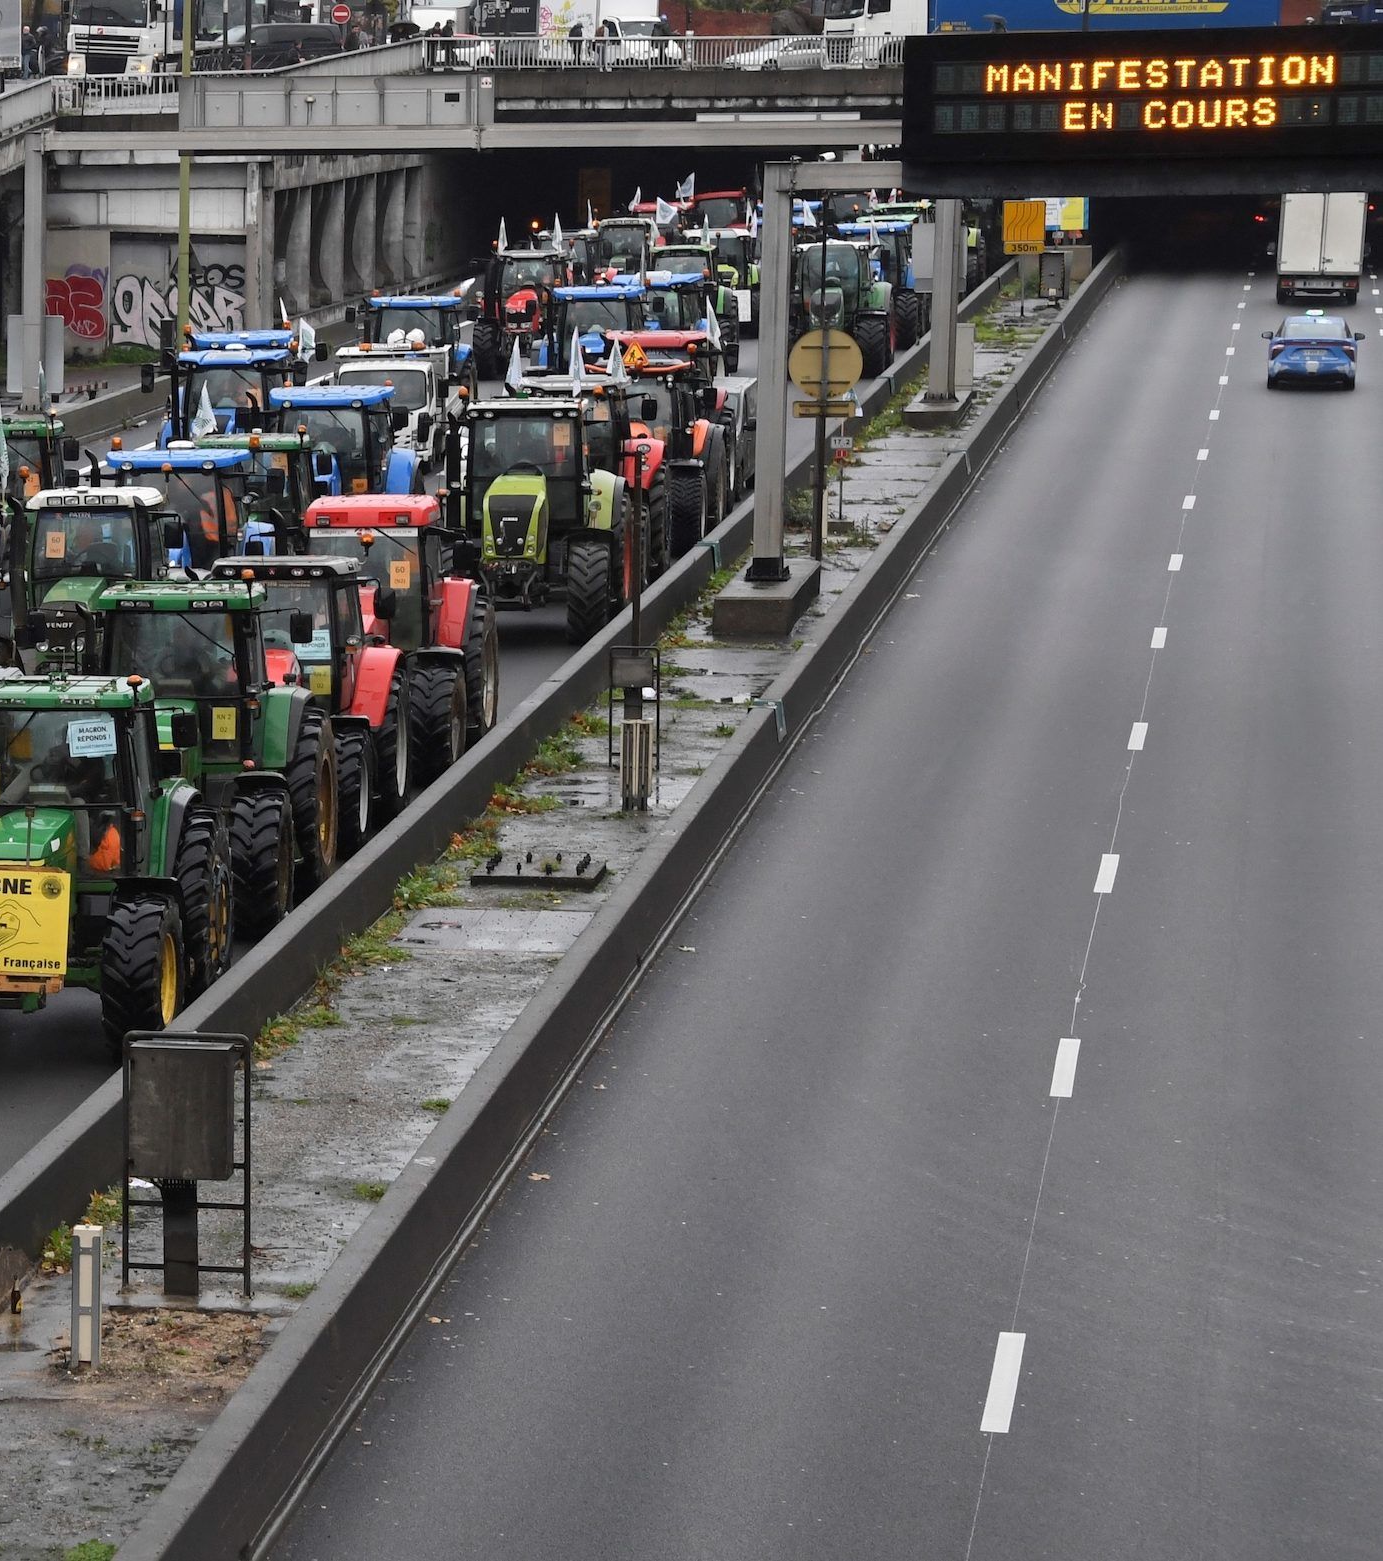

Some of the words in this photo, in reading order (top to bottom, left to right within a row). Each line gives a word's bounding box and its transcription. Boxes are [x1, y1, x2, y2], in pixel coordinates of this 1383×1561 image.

[985, 54, 1335, 93] MANIFESTATION
[1063, 101, 1114, 131] EN
[1143, 97, 1278, 129] COURS
[1011, 244, 1038, 252] 350m
[3, 957, 61, 971] Française
